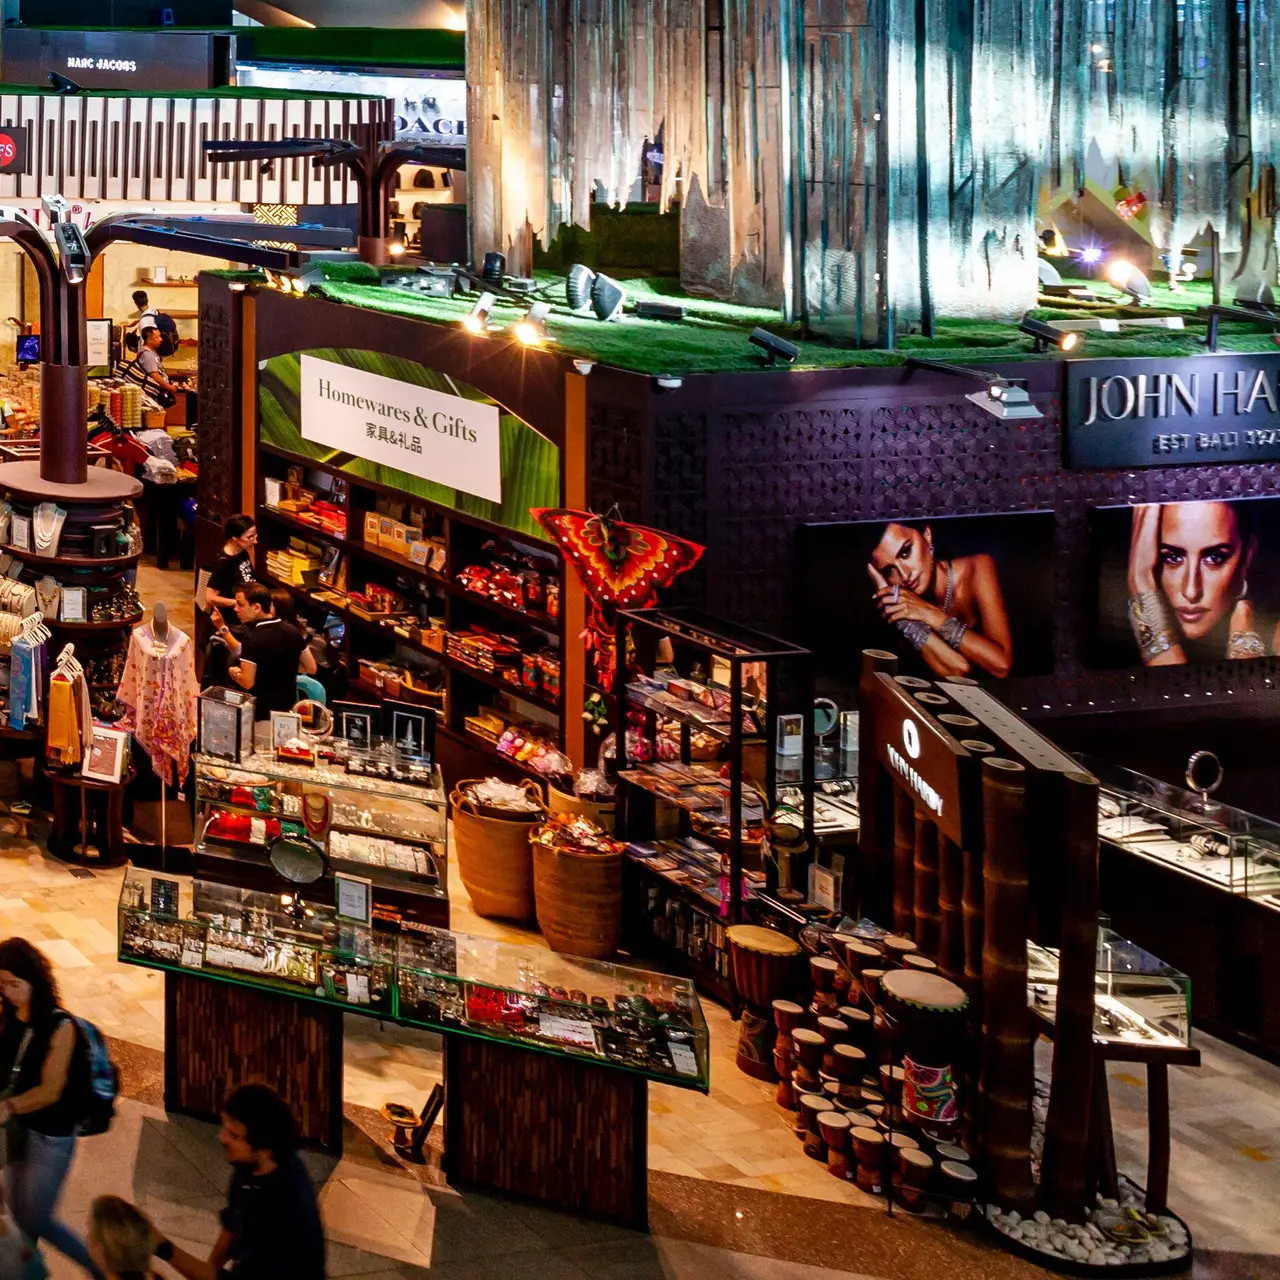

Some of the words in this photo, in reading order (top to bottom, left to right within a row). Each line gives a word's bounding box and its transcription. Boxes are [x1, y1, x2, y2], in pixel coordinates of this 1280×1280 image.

[67, 57, 94, 69] MARC
[96, 58, 137, 72] JACOBS
[394, 115, 466, 135] OAC
[1084, 373, 1200, 426] JOHN
[1216, 369, 1280, 414] HA
[318, 378, 411, 424] Homewares
[413, 406, 429, 429] &
[432, 411, 478, 444] Gifts
[365, 422, 423, 455] 家具&礼品
[1198, 432, 1238, 449] BALI
